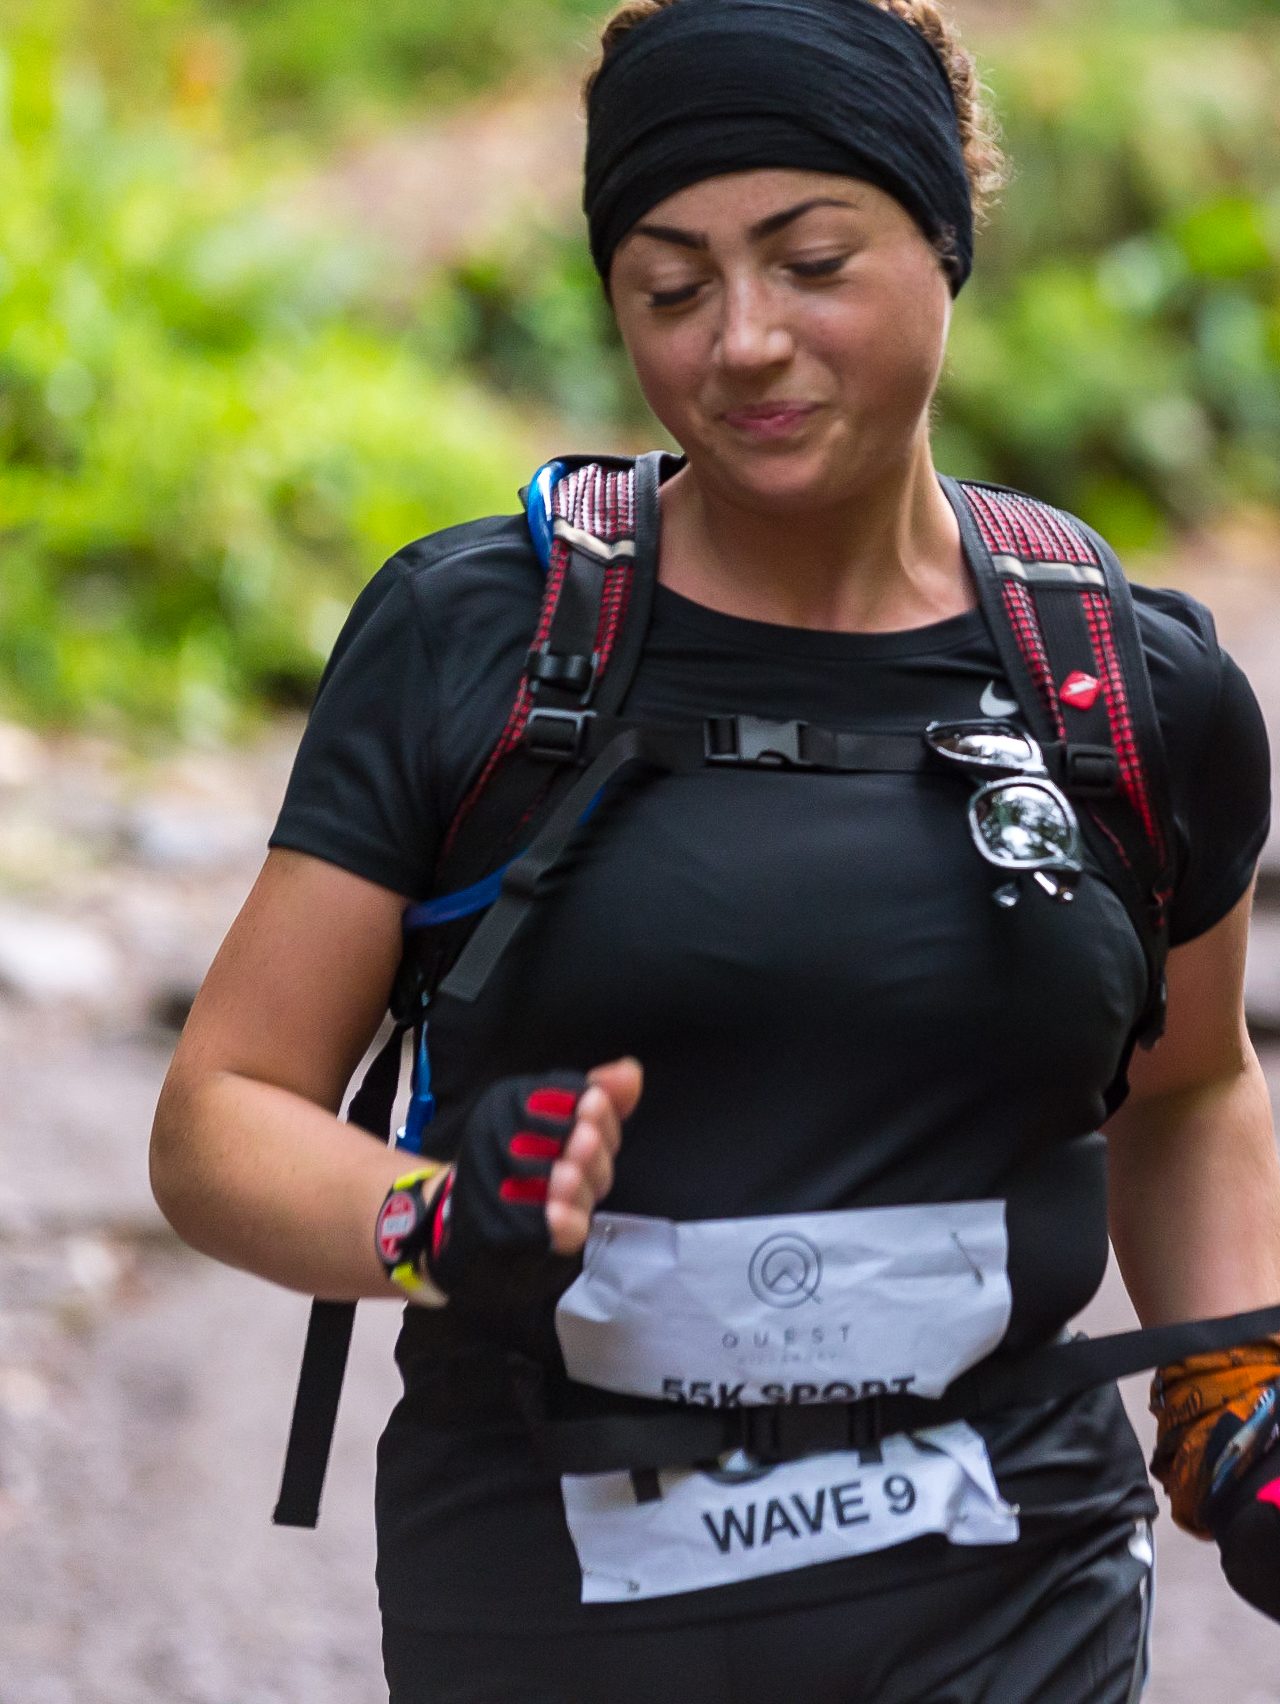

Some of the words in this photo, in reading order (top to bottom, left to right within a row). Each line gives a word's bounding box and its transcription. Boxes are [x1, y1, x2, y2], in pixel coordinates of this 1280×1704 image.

[721, 1323, 850, 1349] QUEST
[661, 1377, 747, 1407] 55K
[701, 1480, 871, 1554] WAVE
[882, 1474, 916, 1516] 9
